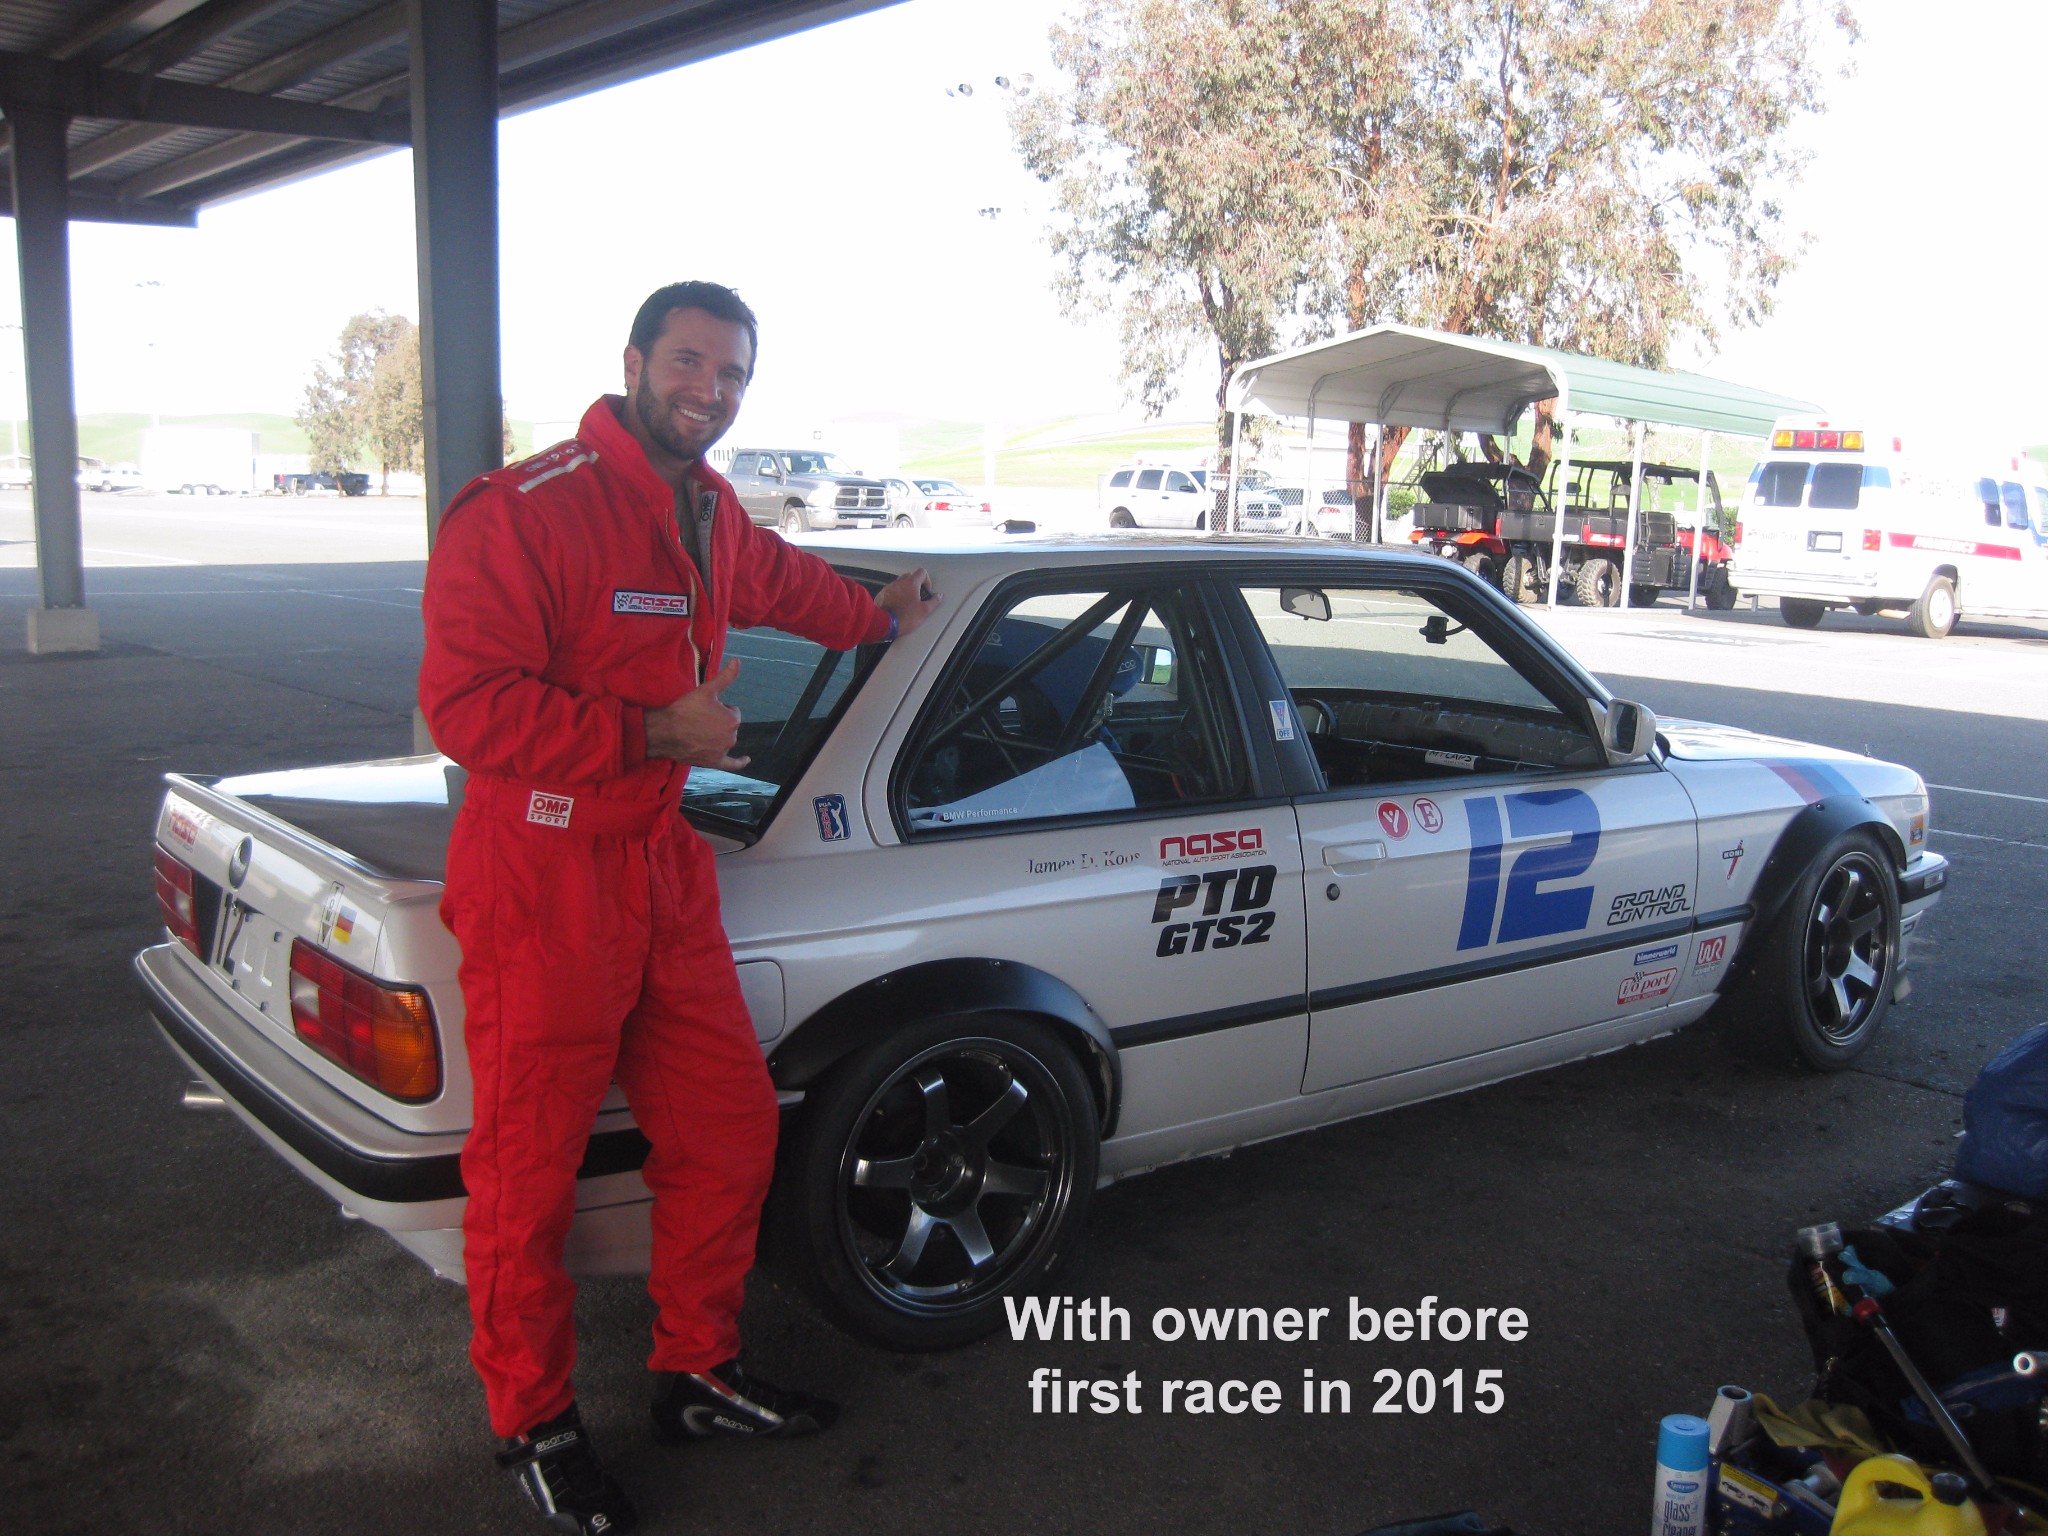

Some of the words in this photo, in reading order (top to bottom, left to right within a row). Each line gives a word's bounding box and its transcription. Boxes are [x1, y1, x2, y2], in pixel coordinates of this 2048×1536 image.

[629, 596, 685, 607] nasa
[1279, 730, 1290, 738] OFF
[533, 797, 569, 814] OMP
[943, 810, 965, 821] BMW
[966, 807, 1018, 819] Performance
[530, 813, 567, 826] SPORT
[1160, 828, 1262, 860] nasa
[1723, 849, 1743, 859] KONI
[1162, 858, 1191, 867] NATIONAL
[1210, 853, 1230, 862] SPORT
[1230, 849, 1267, 859] ASSOCIATION
[1457, 788, 1601, 951] 12
[1151, 865, 1277, 923] PTD
[1611, 884, 1686, 910] GROUND
[1607, 898, 1690, 926] CONTROL
[1156, 911, 1276, 957] GTS2
[1640, 972, 1670, 993] port
[713, 1414, 754, 1433] sparco
[535, 1430, 577, 1451] sparco
[1664, 1500, 1690, 1522] glass
